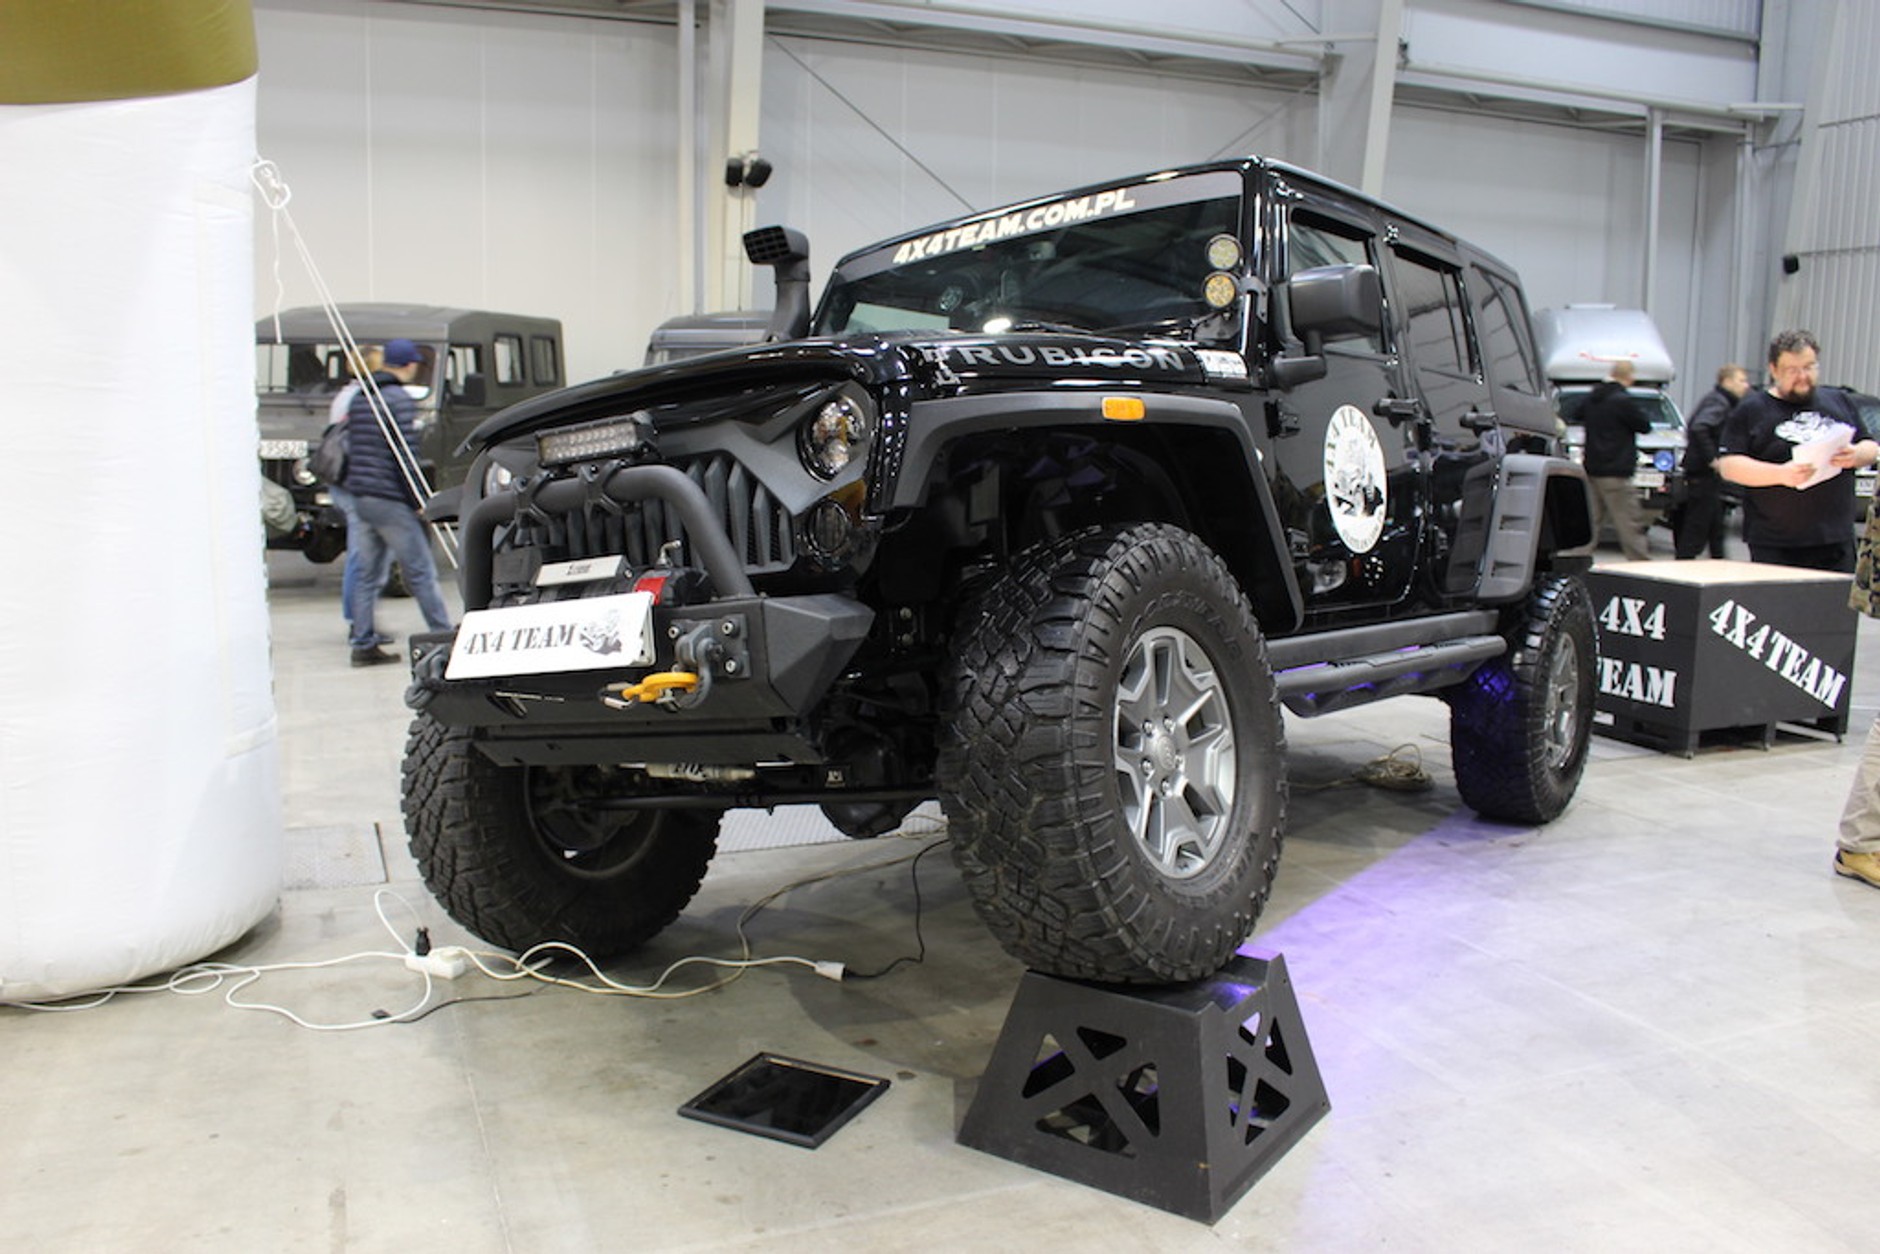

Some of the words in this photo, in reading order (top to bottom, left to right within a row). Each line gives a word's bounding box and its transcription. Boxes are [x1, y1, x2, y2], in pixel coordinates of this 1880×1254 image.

[893, 189, 1135, 264] 4X4TEAM.COM.PL
[957, 347, 1184, 371] RUBICON
[464, 630, 505, 654] 4X4
[512, 624, 577, 651] TEAM
[1599, 595, 1667, 641] 4X4
[1597, 656, 1677, 708] EAM
